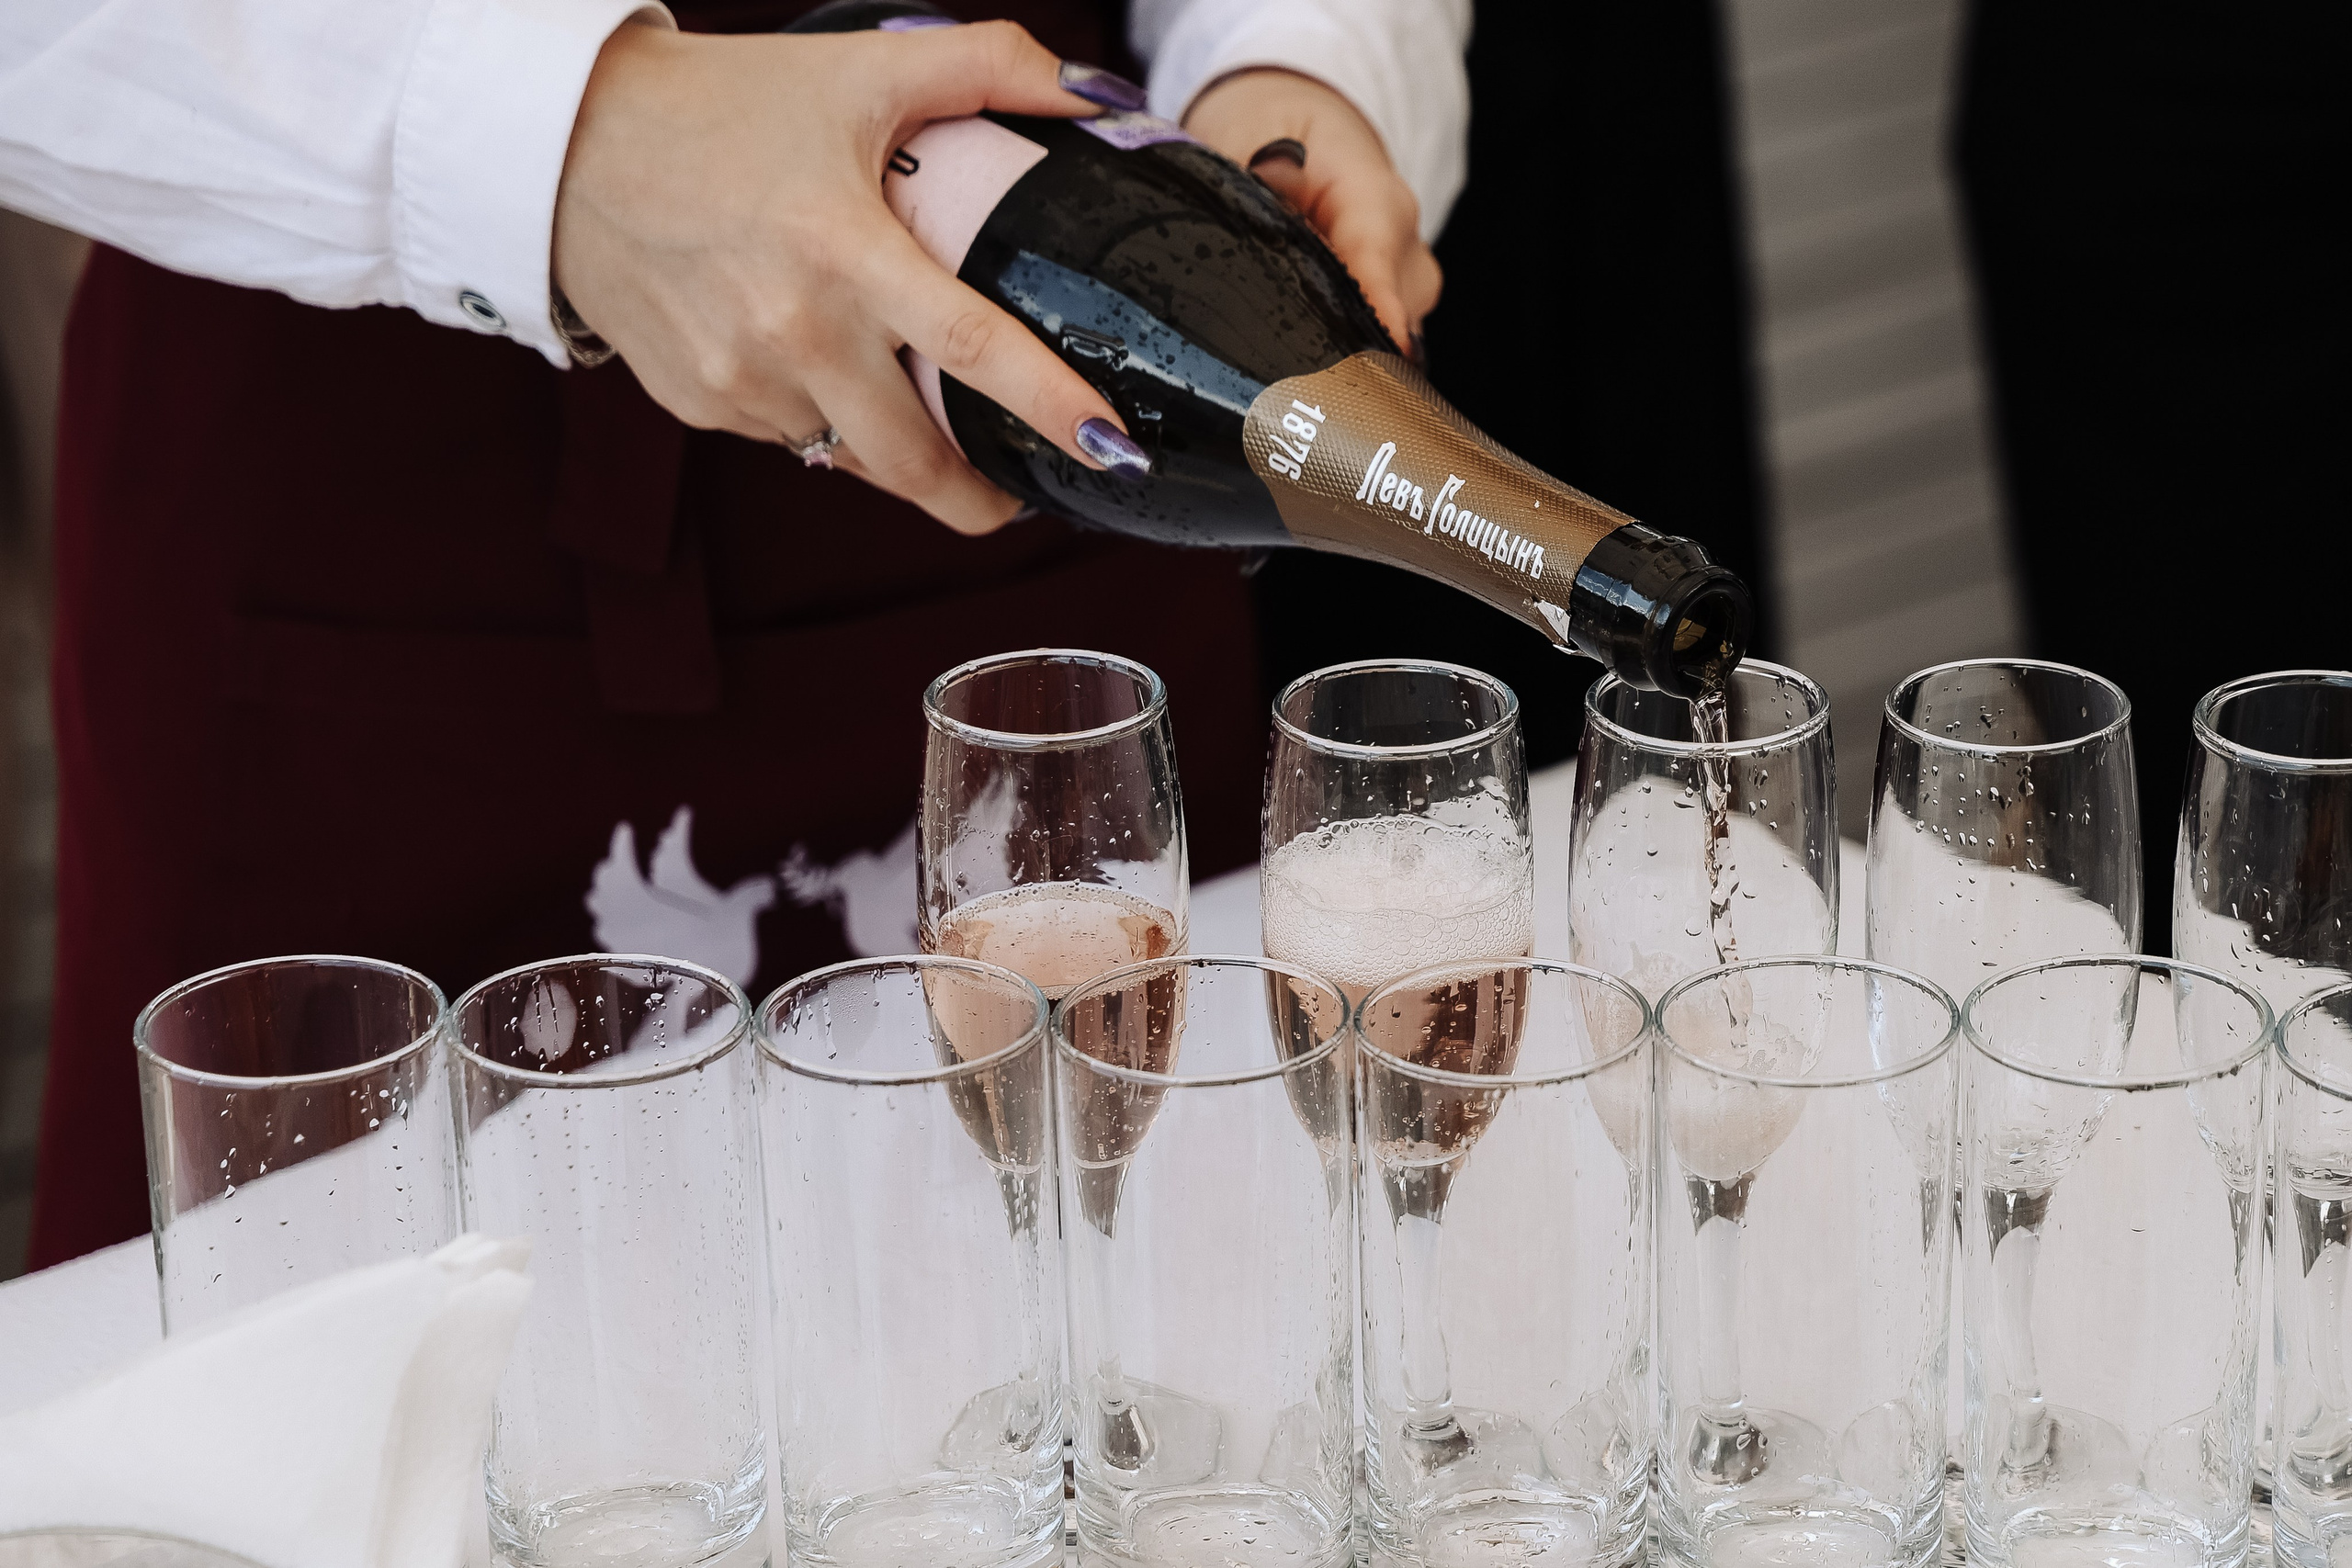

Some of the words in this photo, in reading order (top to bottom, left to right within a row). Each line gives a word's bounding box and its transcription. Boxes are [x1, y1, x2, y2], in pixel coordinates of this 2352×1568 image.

[1269, 399, 1327, 481] 1876
[1355, 440, 1424, 521] Левъ
[1424, 473, 1545, 580] Голицынъ
